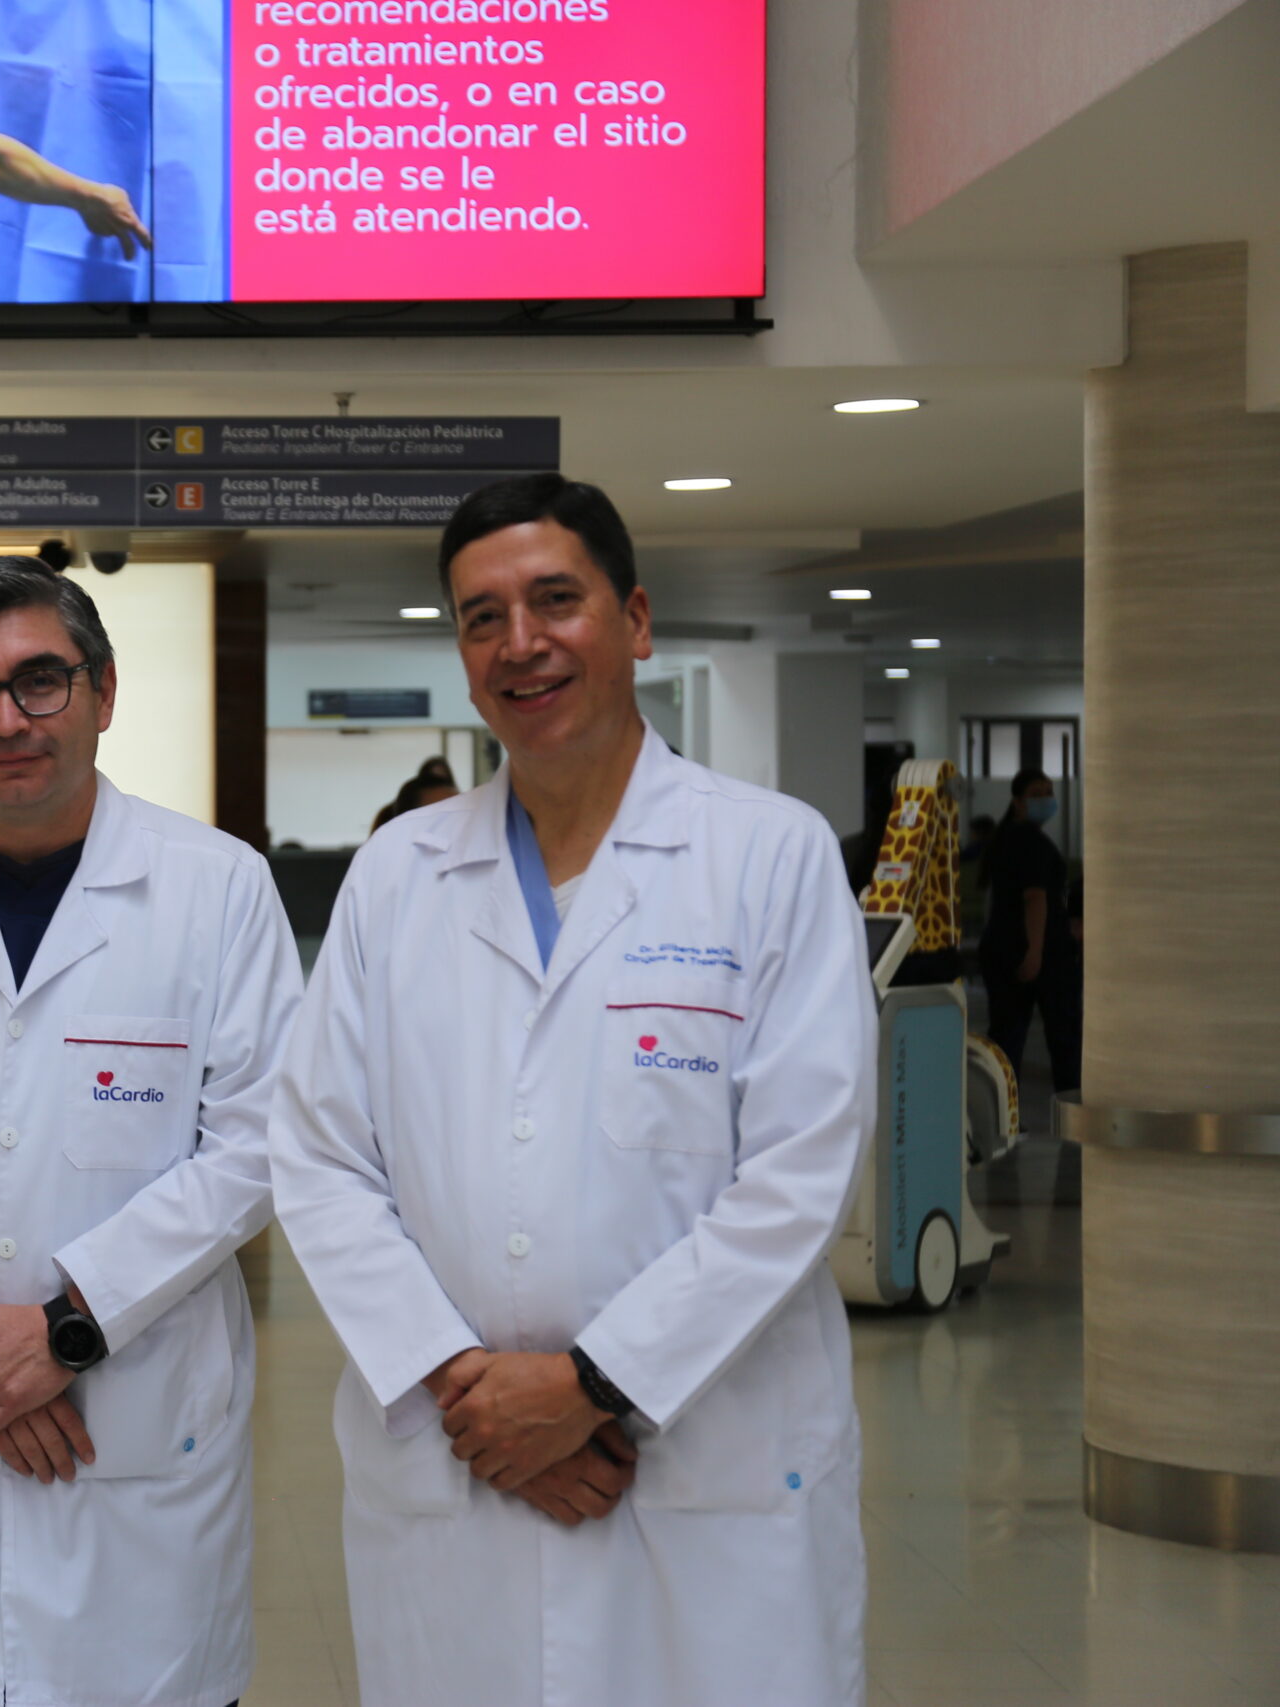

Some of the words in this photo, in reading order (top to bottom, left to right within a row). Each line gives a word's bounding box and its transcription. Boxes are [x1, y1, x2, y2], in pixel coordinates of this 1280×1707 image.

[254, 0, 609, 25] recomendaciones
[254, 42, 280, 66] o
[297, 35, 543, 66] tratamientos
[254, 75, 449, 112] ofrecidos,
[467, 82, 491, 107] o
[509, 81, 557, 106] en
[575, 78, 665, 104] caso
[254, 116, 305, 150] de
[322, 114, 537, 149] abandonar
[554, 114, 588, 147] el
[604, 114, 687, 147] sitio
[254, 156, 384, 191] donde
[400, 165, 445, 190] se
[462, 156, 495, 189] le
[254, 201, 336, 233] está
[353, 197, 589, 231] atendiendo.
[13, 422, 66, 435] Adultos
[222, 426, 269, 438] Acceso
[273, 426, 310, 438] Torre
[312, 426, 323, 438] C
[325, 425, 429, 441] Hospitalización
[434, 425, 503, 438] Pediátrica
[181, 431, 195, 449] C
[347, 442, 385, 454] Tower
[389, 442, 401, 454] C
[404, 442, 463, 454] Entrance
[13, 477, 66, 490] Adultos
[222, 478, 269, 490] Acceso
[273, 478, 309, 490] Torre
[312, 478, 320, 490] E
[183, 487, 195, 505] E
[222, 493, 270, 506] Central
[274, 493, 292, 506] de
[295, 493, 349, 508] Entrega
[352, 493, 370, 506] de
[373, 493, 460, 506] Documentos
[266, 508, 277, 521] E
[634, 1051, 719, 1073] laCardio
[93, 1086, 164, 1102] laCardio
